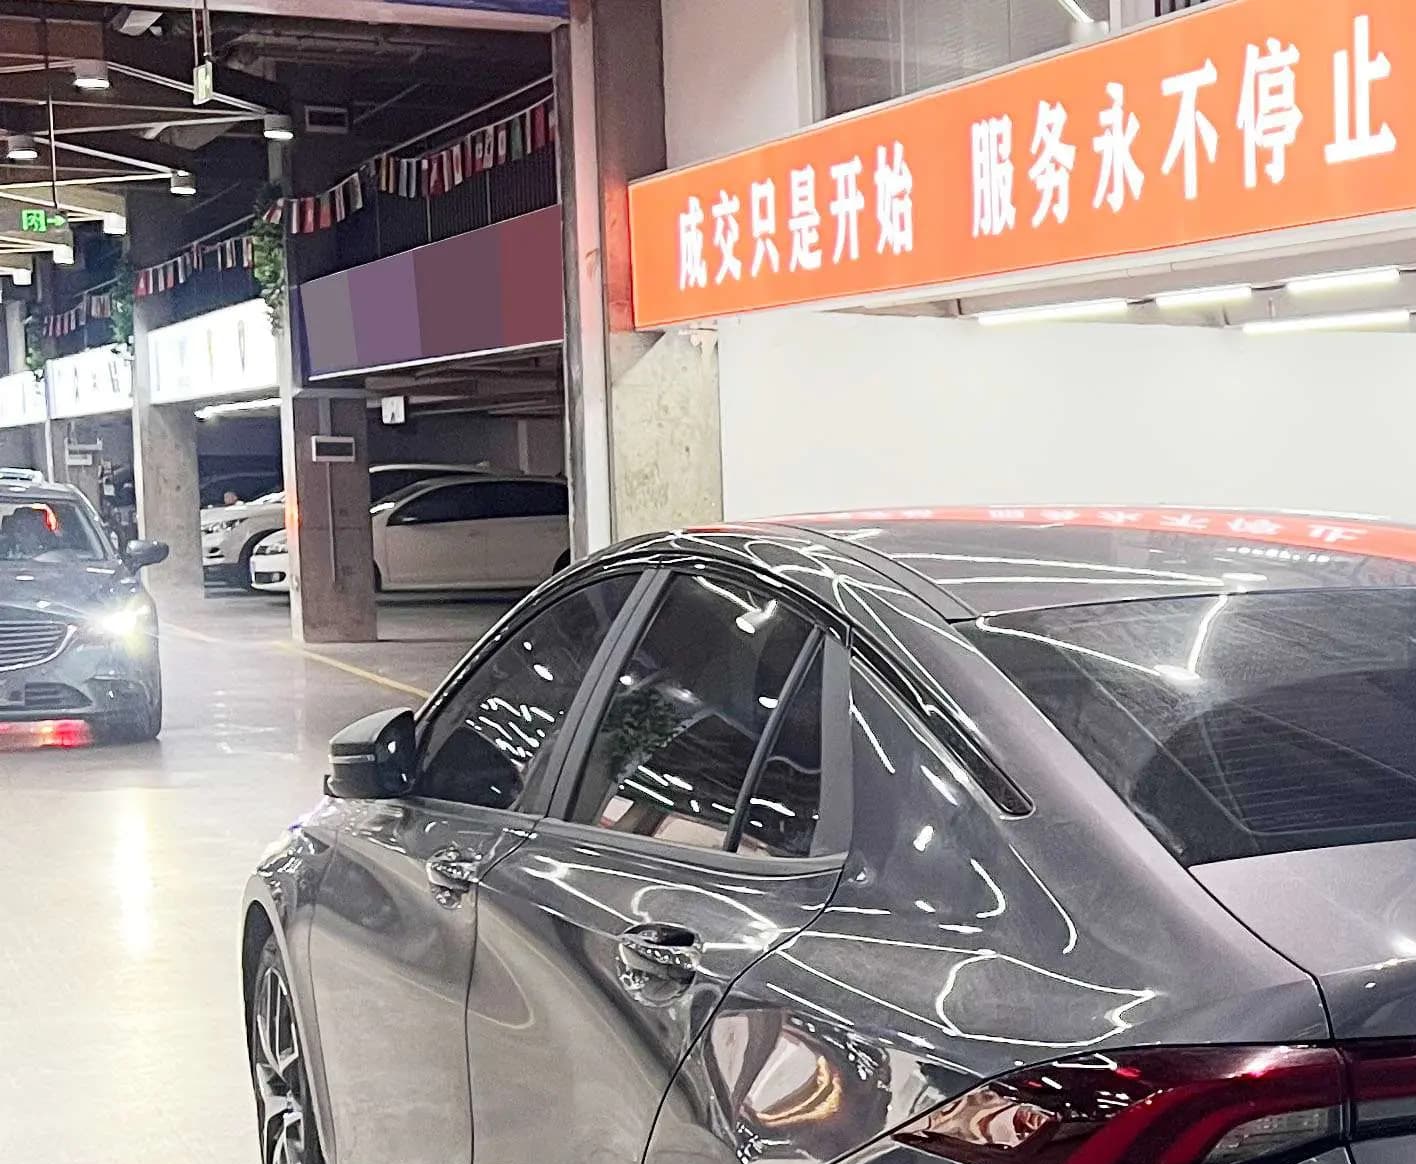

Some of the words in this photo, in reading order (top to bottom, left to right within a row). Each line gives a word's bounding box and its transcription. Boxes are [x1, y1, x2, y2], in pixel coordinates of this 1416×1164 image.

[678, 140, 914, 290] 成交只是开始
[970, 15, 1397, 238] 服务永不停止
